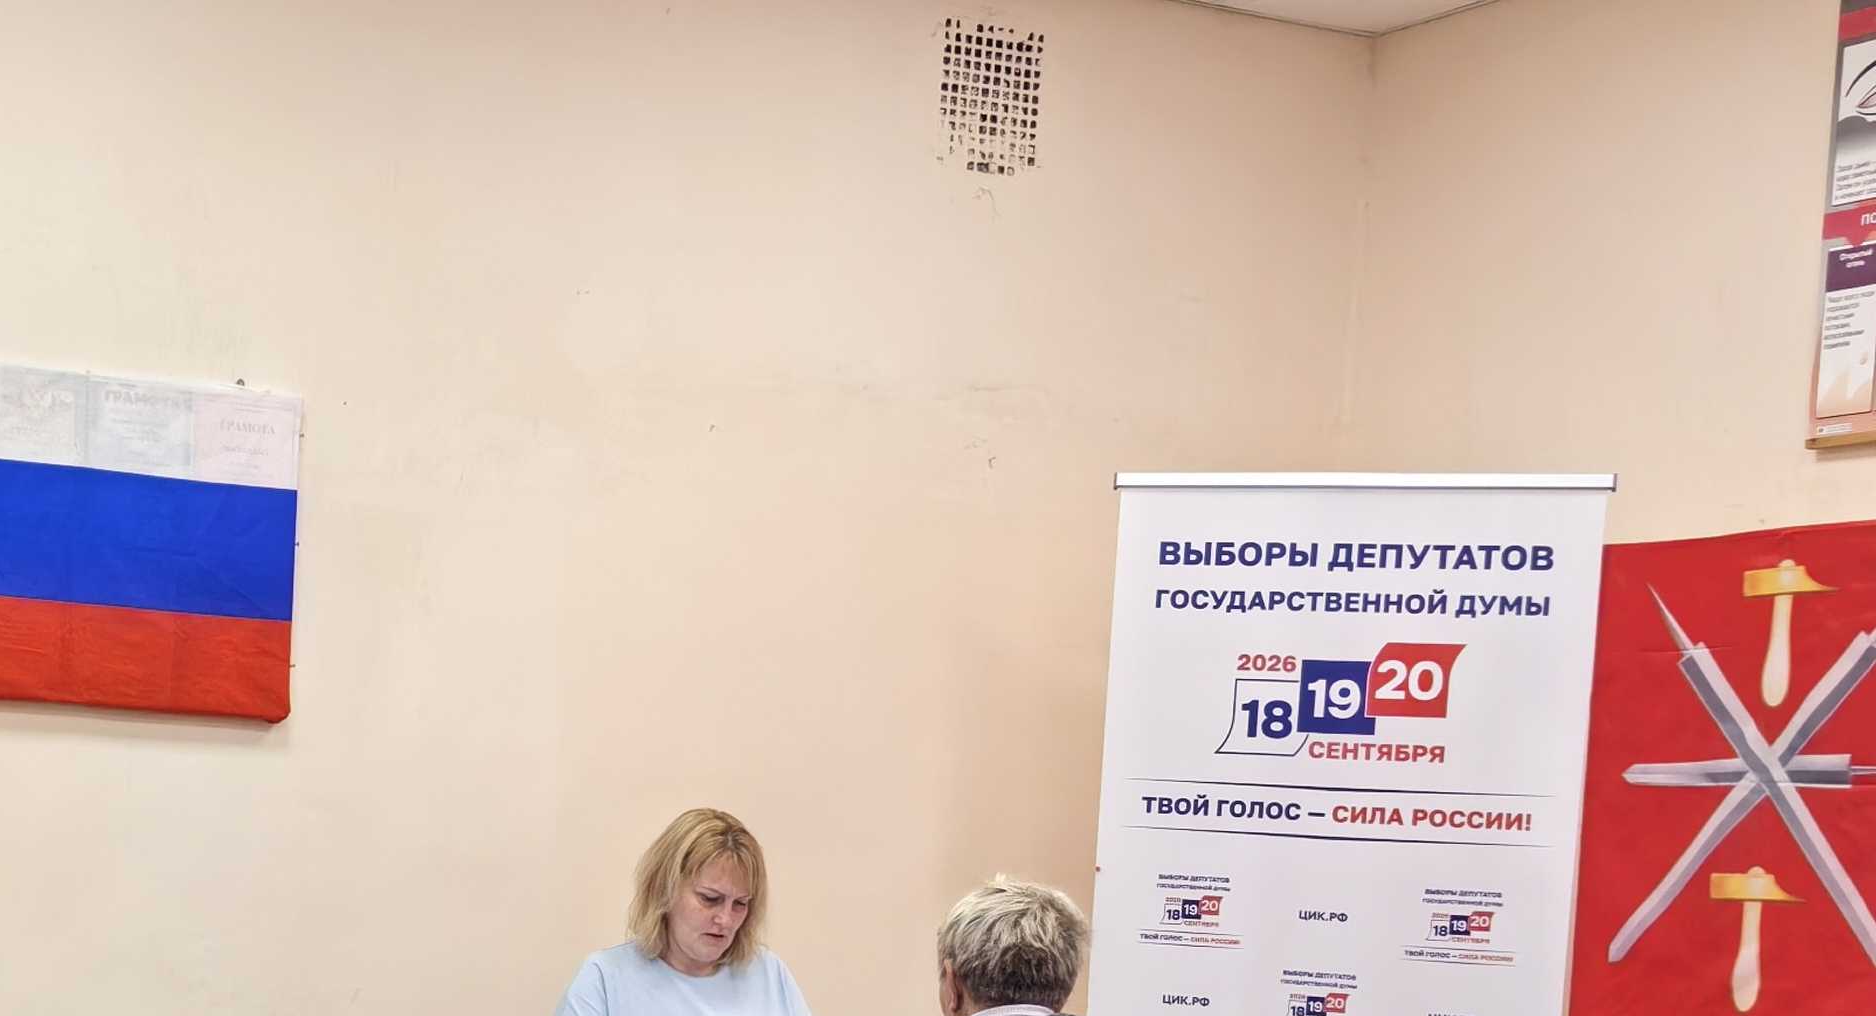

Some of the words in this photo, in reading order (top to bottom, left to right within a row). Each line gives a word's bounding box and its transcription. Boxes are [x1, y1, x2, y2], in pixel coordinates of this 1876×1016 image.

[1158, 541, 1318, 567] ВЫБОРЫ
[1327, 543, 1554, 573] ДЕПУТАТОВ
[1155, 588, 1448, 615] ГОСУДАРСТВЕННОЙ
[1455, 594, 1551, 619] ДУМЫ
[1236, 653, 1296, 673] 2026
[1241, 700, 1293, 739] 18
[1308, 679, 1361, 719] 19
[1374, 660, 1443, 701] 20
[1308, 741, 1446, 764] СЕНТЯБРЯ
[1142, 794, 1210, 818] ТВОЙ
[1216, 799, 1301, 821] ГОЛОС
[1332, 805, 1405, 827] СИЛА
[1412, 809, 1531, 832] РОССИИ!
[1166, 909, 1180, 920] 18
[1184, 904, 1197, 915] 19
[1201, 901, 1218, 911] 20
[1298, 910, 1348, 924] ЦИК.РФ
[1433, 925, 1448, 936] 18
[1452, 920, 1467, 931] 19
[1470, 916, 1489, 927] 20
[1162, 994, 1210, 1008] ЦИК.РФ
[1290, 1005, 1305, 1016] 18
[1308, 1001, 1322, 1012] 19
[1326, 998, 1344, 1008] 20
